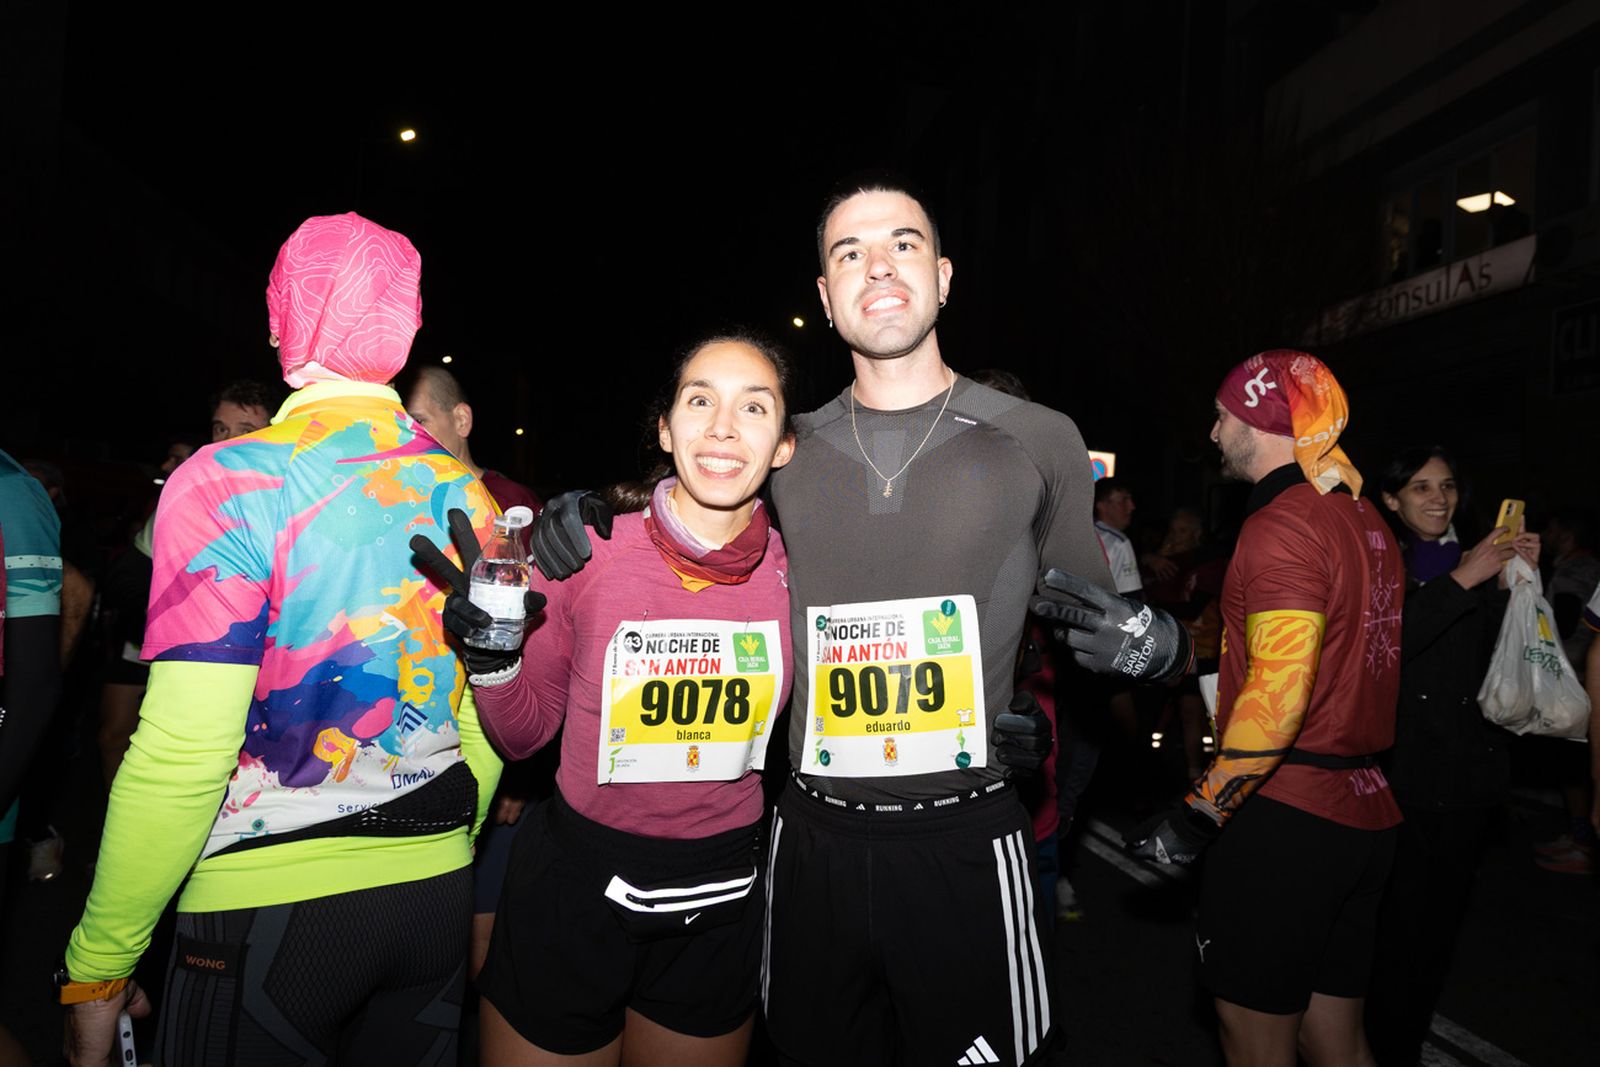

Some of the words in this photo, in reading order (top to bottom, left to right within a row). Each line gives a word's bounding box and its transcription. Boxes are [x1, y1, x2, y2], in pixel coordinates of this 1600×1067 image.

[625, 635, 642, 647] 43
[831, 622, 881, 641] NOCHE
[885, 620, 905, 637] DE
[646, 639, 697, 655] NOCHE
[702, 638, 720, 653] DE
[847, 638, 908, 663] ANTÓN
[1131, 635, 1155, 677] ANTÓN
[664, 654, 721, 675] ANTÓN
[1123, 649, 1141, 674] SAN
[830, 661, 945, 718] 9079
[640, 677, 750, 726] 9078
[676, 729, 711, 740] blanca
[865, 719, 911, 733] eduardo
[875, 804, 903, 812] RUNNING
[185, 954, 226, 970] WONG
